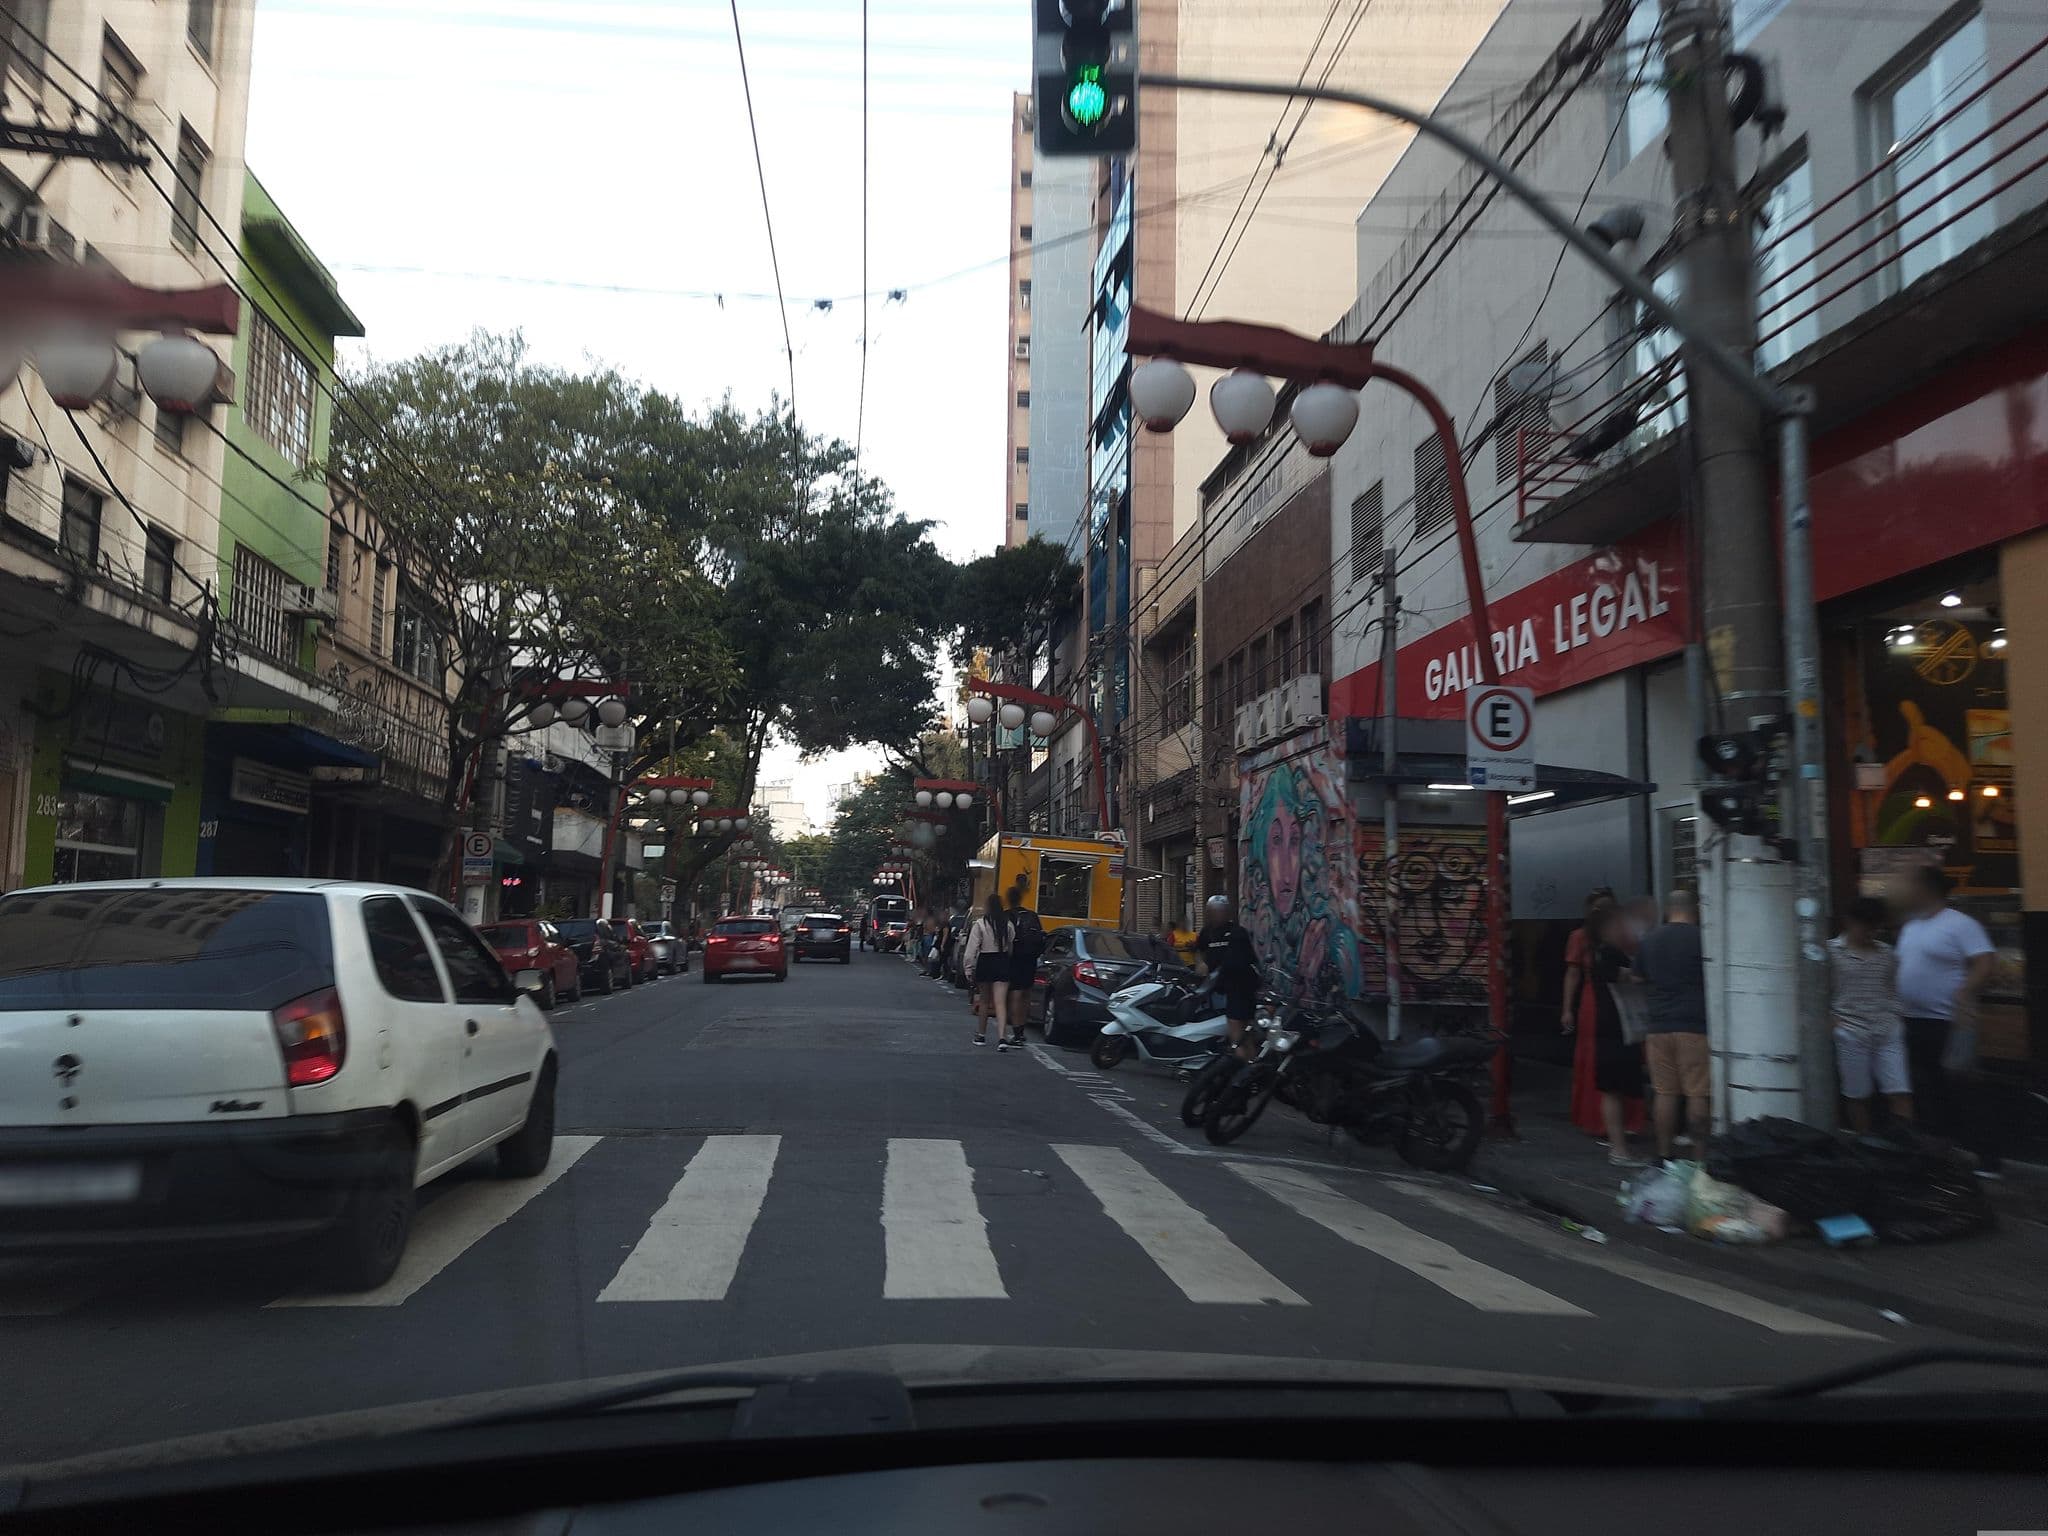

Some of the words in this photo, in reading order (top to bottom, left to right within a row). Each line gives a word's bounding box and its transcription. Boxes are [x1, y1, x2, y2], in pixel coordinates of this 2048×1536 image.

[1553, 559, 1669, 655] LEGAL
[1491, 703, 1512, 737] E
[37, 794, 57, 816] 283
[200, 820, 219, 838] 287
[474, 839, 483, 852] E
